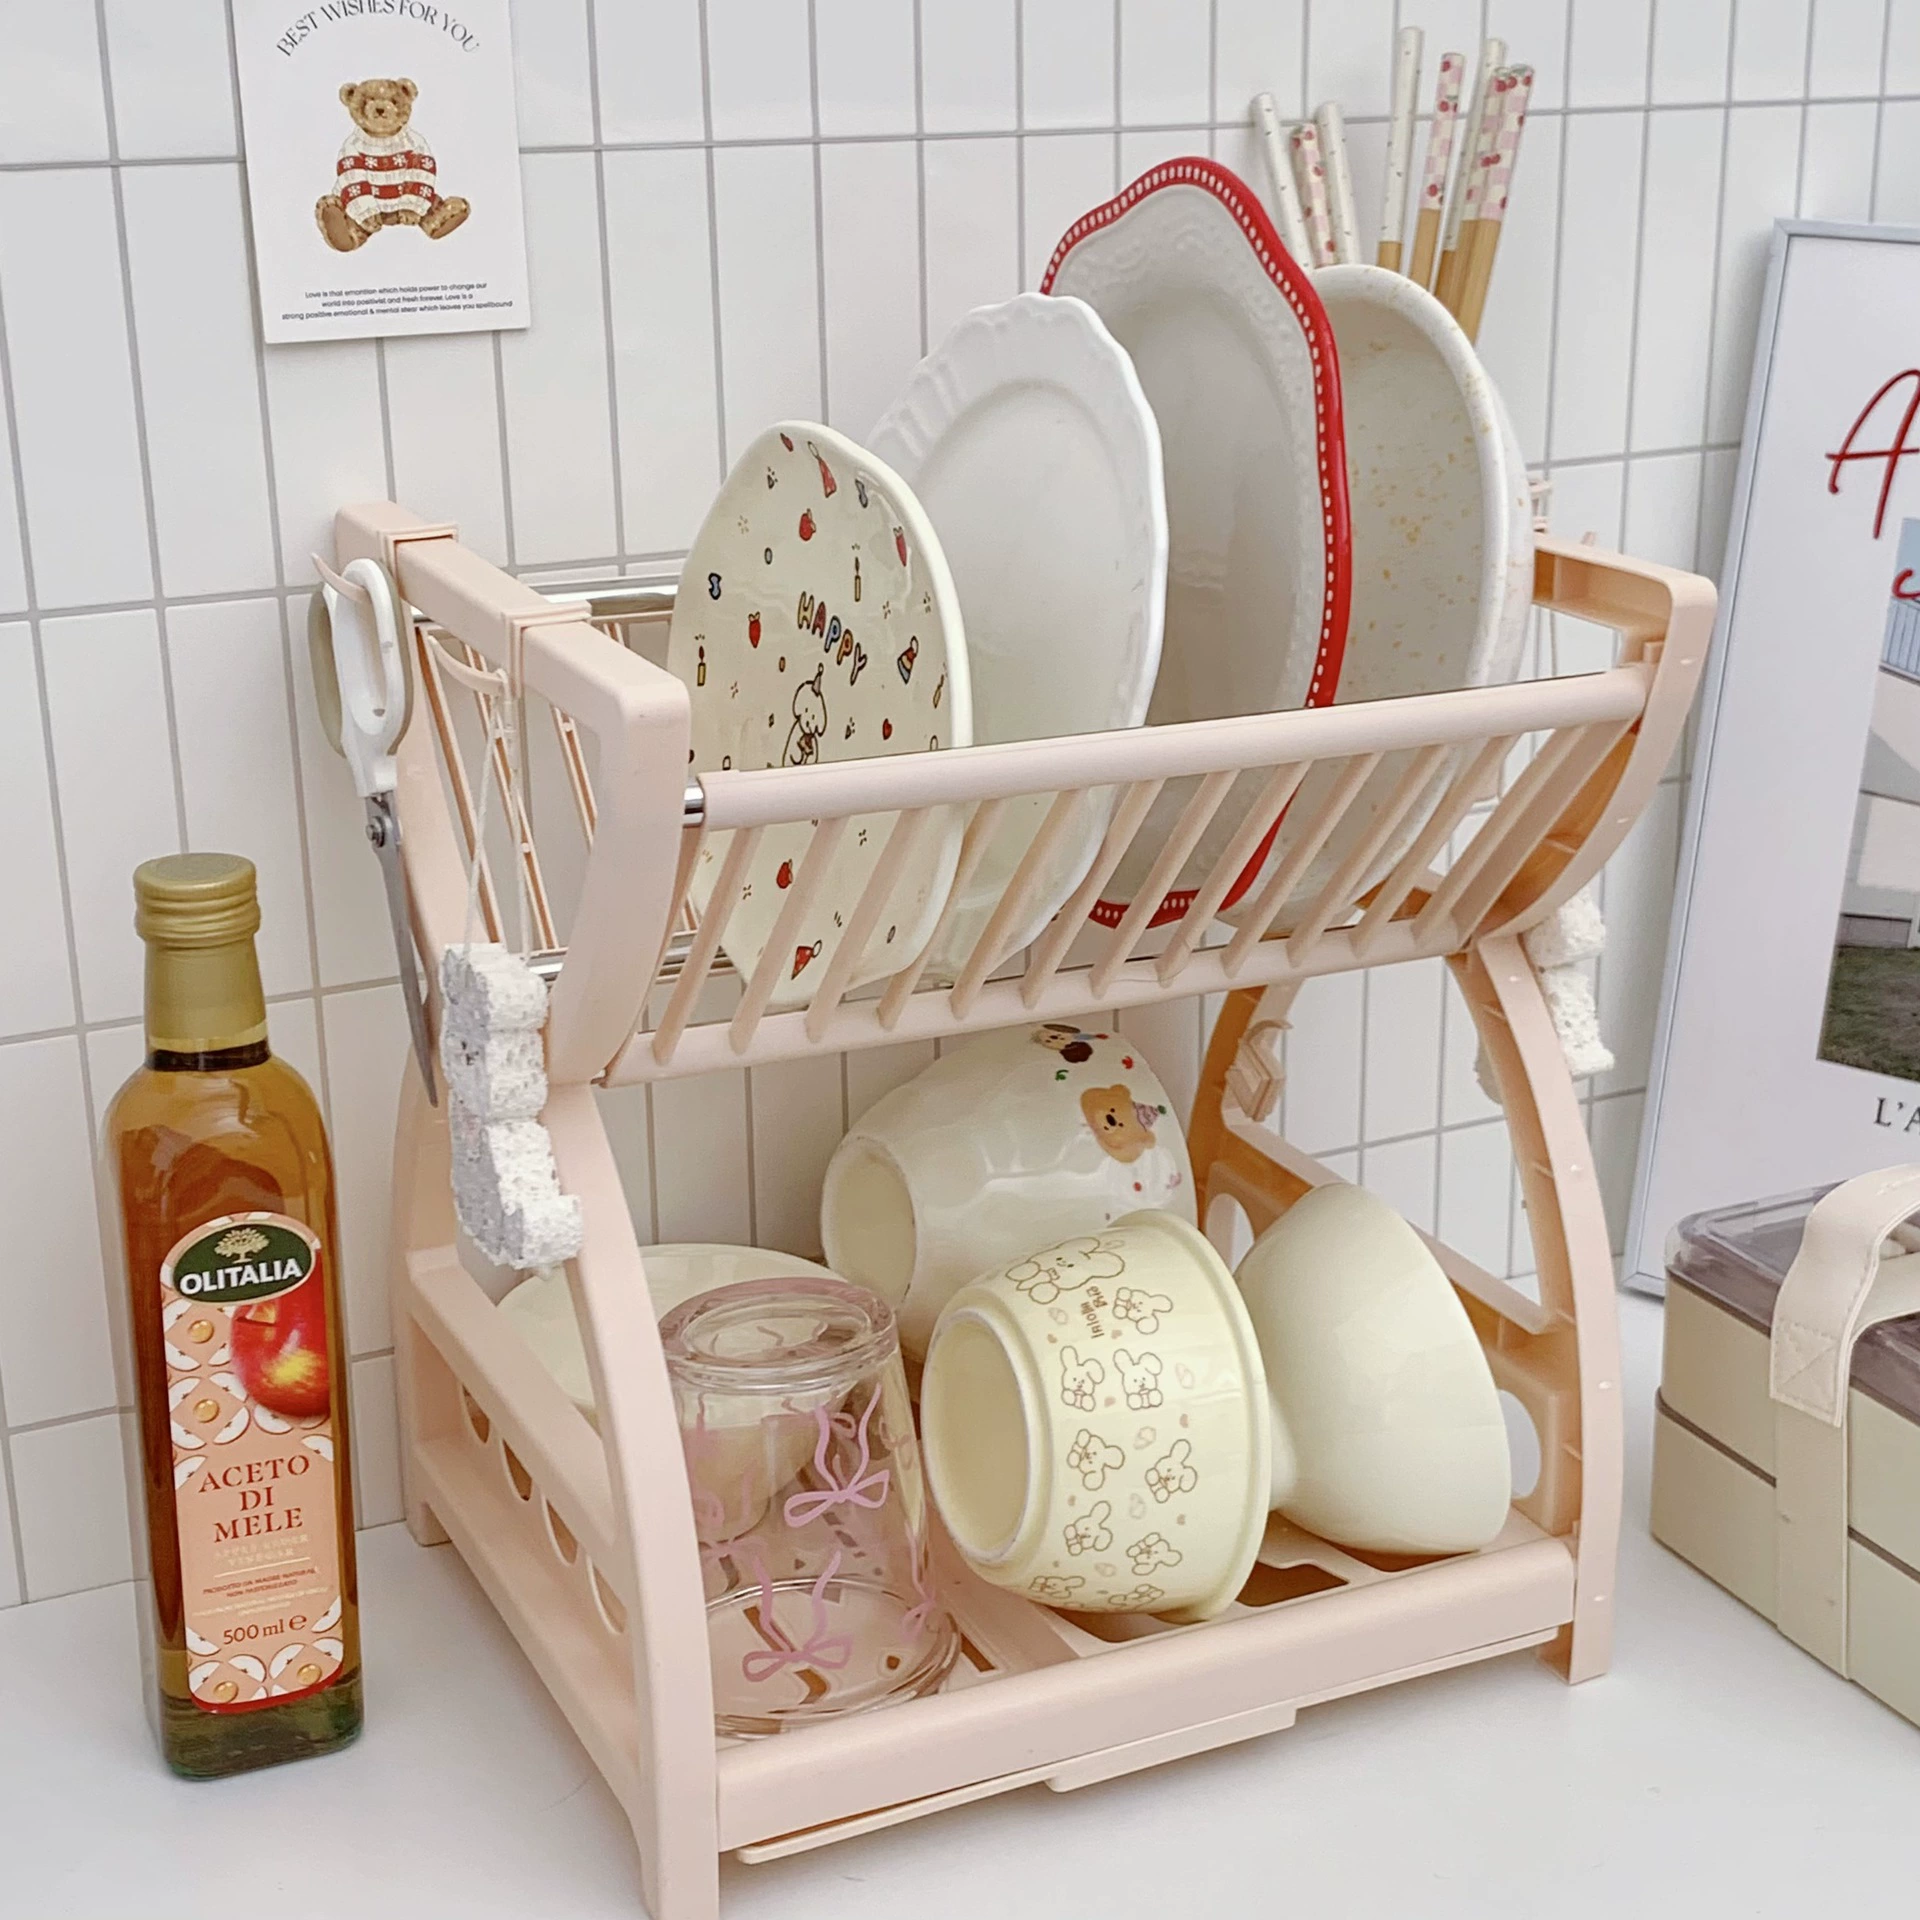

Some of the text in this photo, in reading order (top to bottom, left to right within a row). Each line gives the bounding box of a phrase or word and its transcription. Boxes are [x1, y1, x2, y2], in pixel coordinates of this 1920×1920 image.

[276, 0, 480, 56] BEST WISHES FOR YOU
[305, 291, 321, 299] Love
[419, 285, 440, 293] power
[449, 283, 475, 291] change
[445, 293, 460, 301] Love
[282, 312, 304, 320] strong
[305, 311, 332, 319] positive
[333, 308, 368, 317] emotional
[440, 303, 461, 311] leaves
[475, 300, 513, 309] spellbound
[797, 591, 868, 687] HAPPY
[179, 1257, 303, 1296] OLITALIA
[198, 1455, 310, 1493] ACETO
[238, 1486, 274, 1512] DI
[213, 1507, 303, 1543] MELE
[223, 1624, 259, 1645] 500
[263, 1619, 284, 1637] ml
